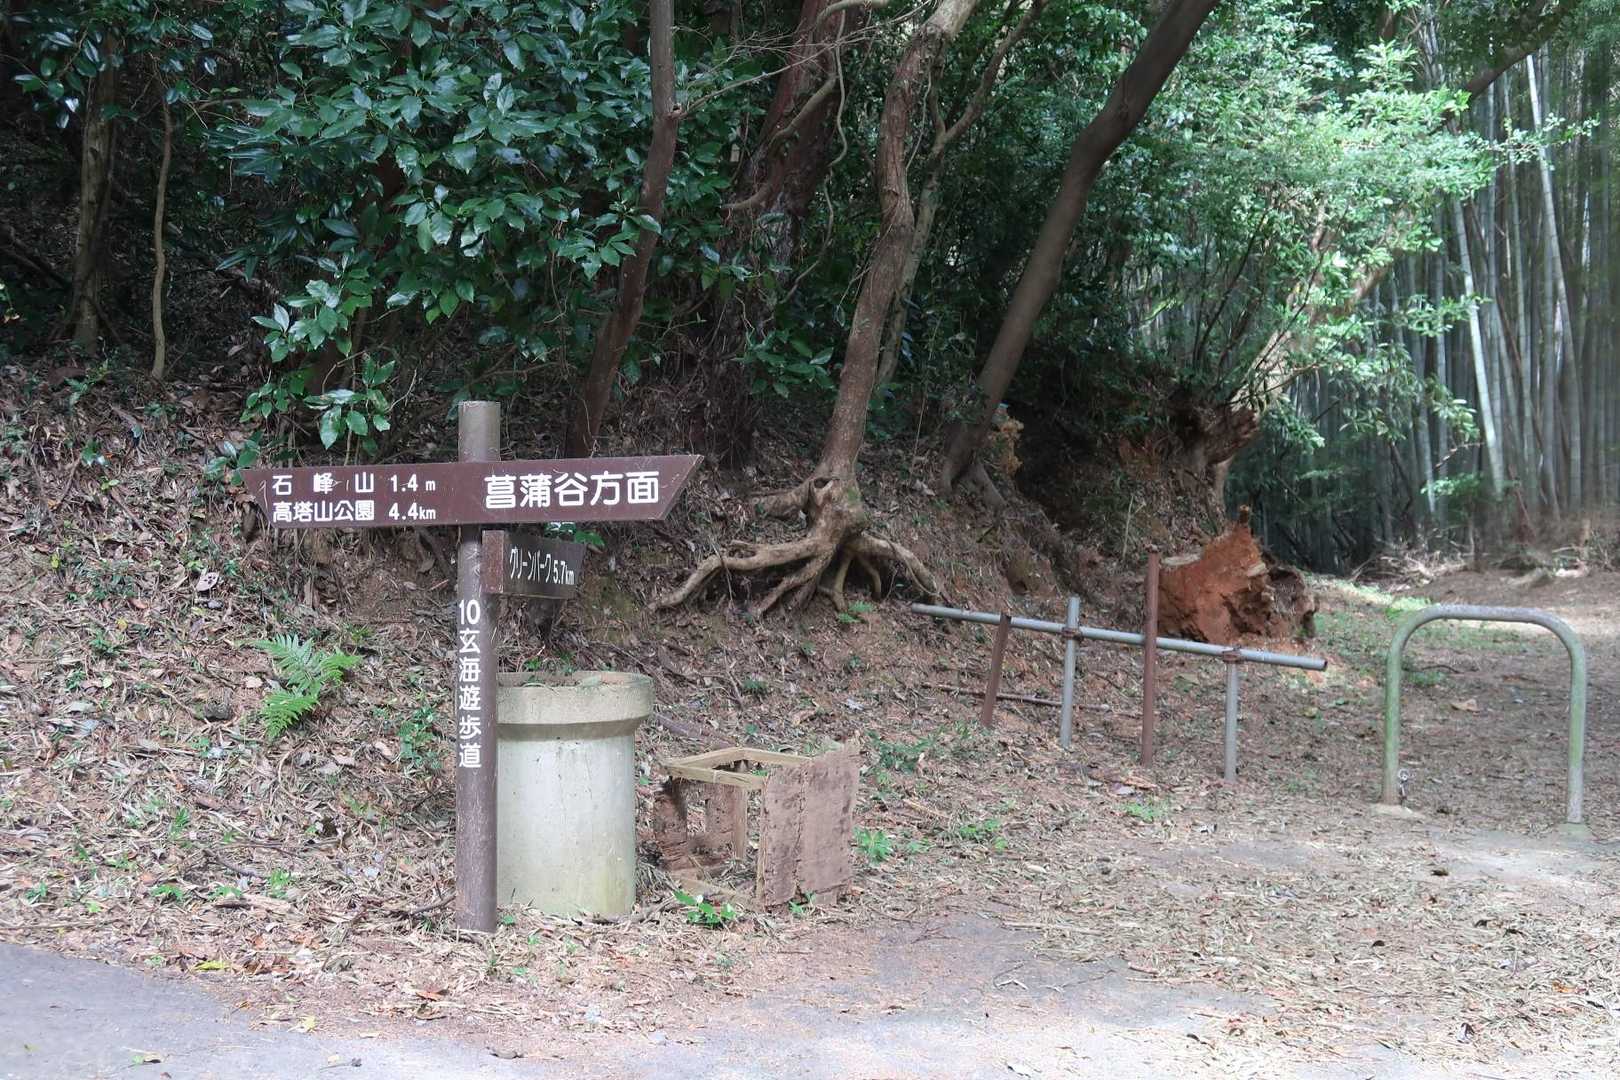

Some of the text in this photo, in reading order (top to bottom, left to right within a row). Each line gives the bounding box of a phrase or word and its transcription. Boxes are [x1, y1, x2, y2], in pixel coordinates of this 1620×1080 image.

[484, 471, 660, 509] 菖蒲谷方面
[272, 500, 437, 522] 高塔山公園 4.4km
